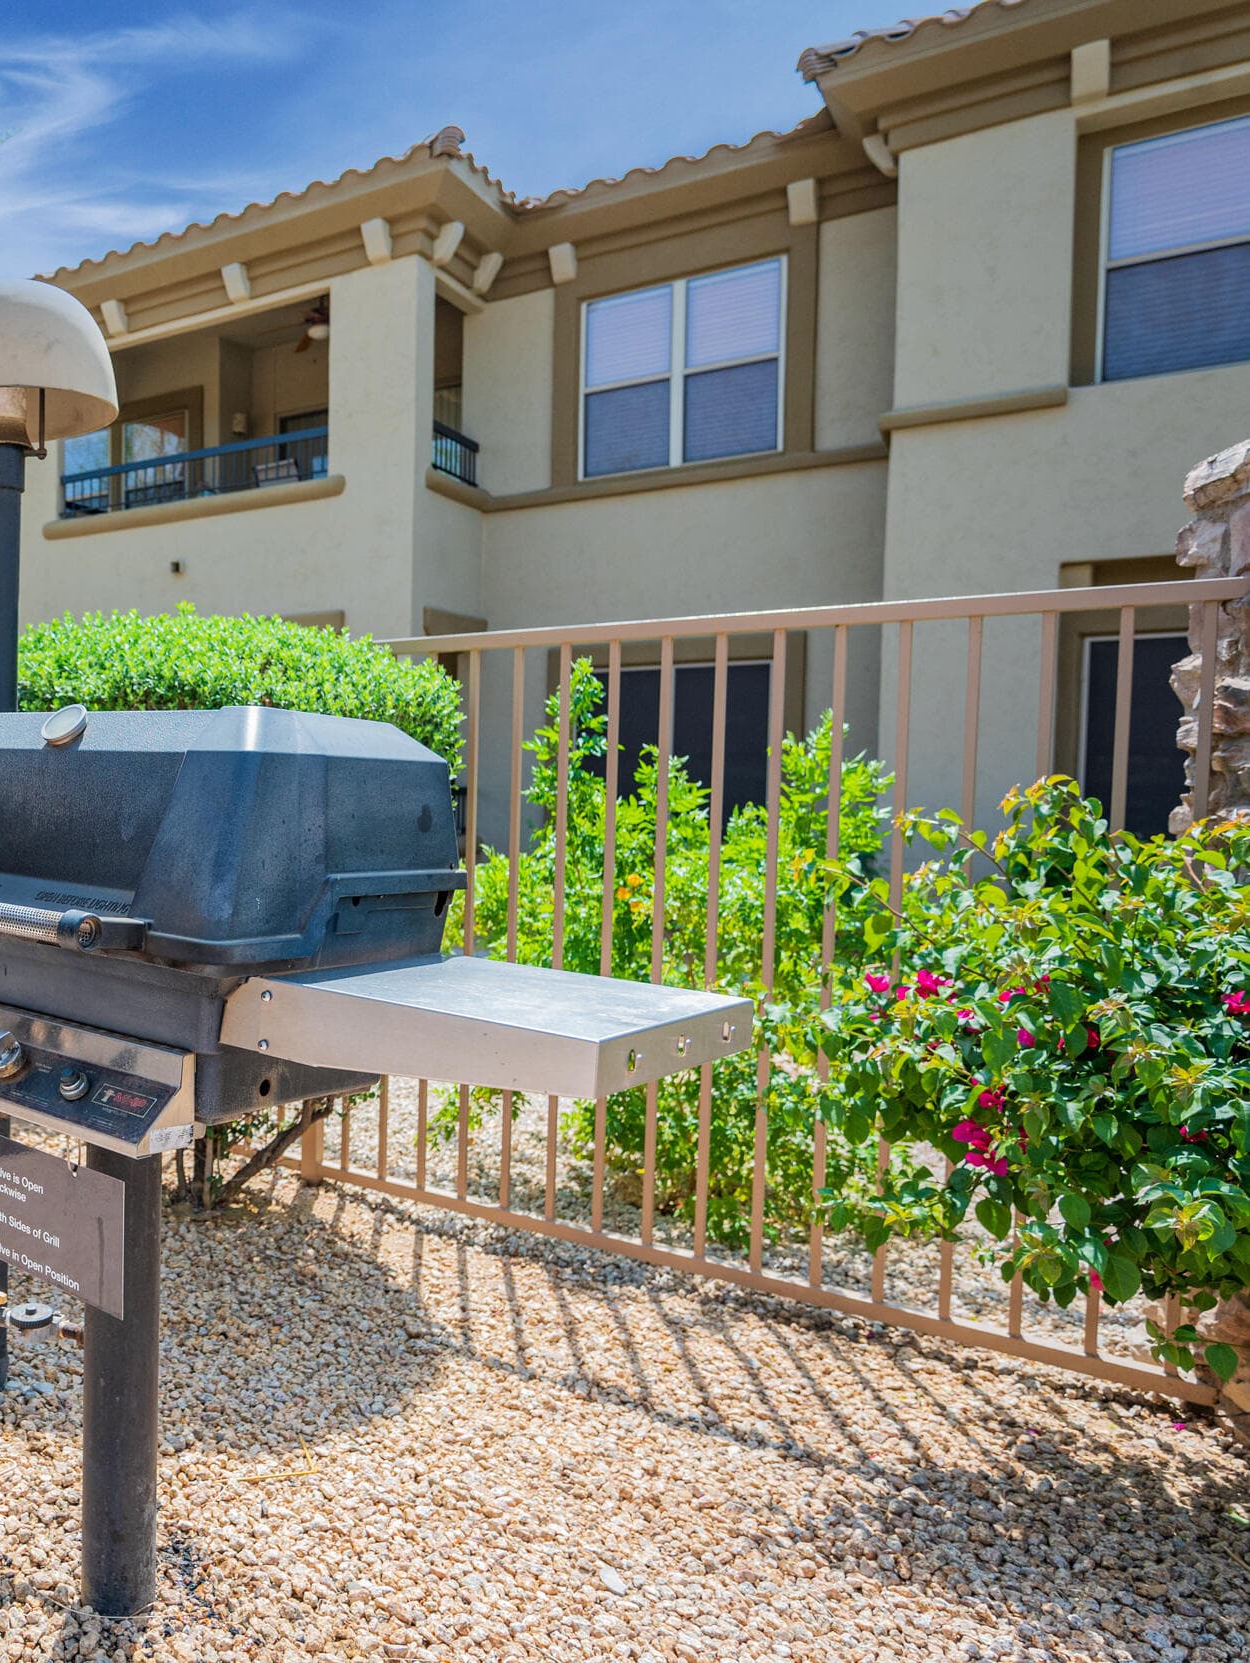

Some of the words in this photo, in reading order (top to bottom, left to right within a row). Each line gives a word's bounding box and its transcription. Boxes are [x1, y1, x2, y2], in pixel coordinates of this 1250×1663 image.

[13, 1173, 20, 1184] is
[21, 1176, 44, 1194] Open
[8, 1216, 31, 1235] Sides
[32, 1229, 42, 1239] of
[43, 1232, 60, 1248] Grill
[12, 1249, 20, 1261] in
[21, 1254, 43, 1273] Open
[45, 1265, 80, 1292] Position
